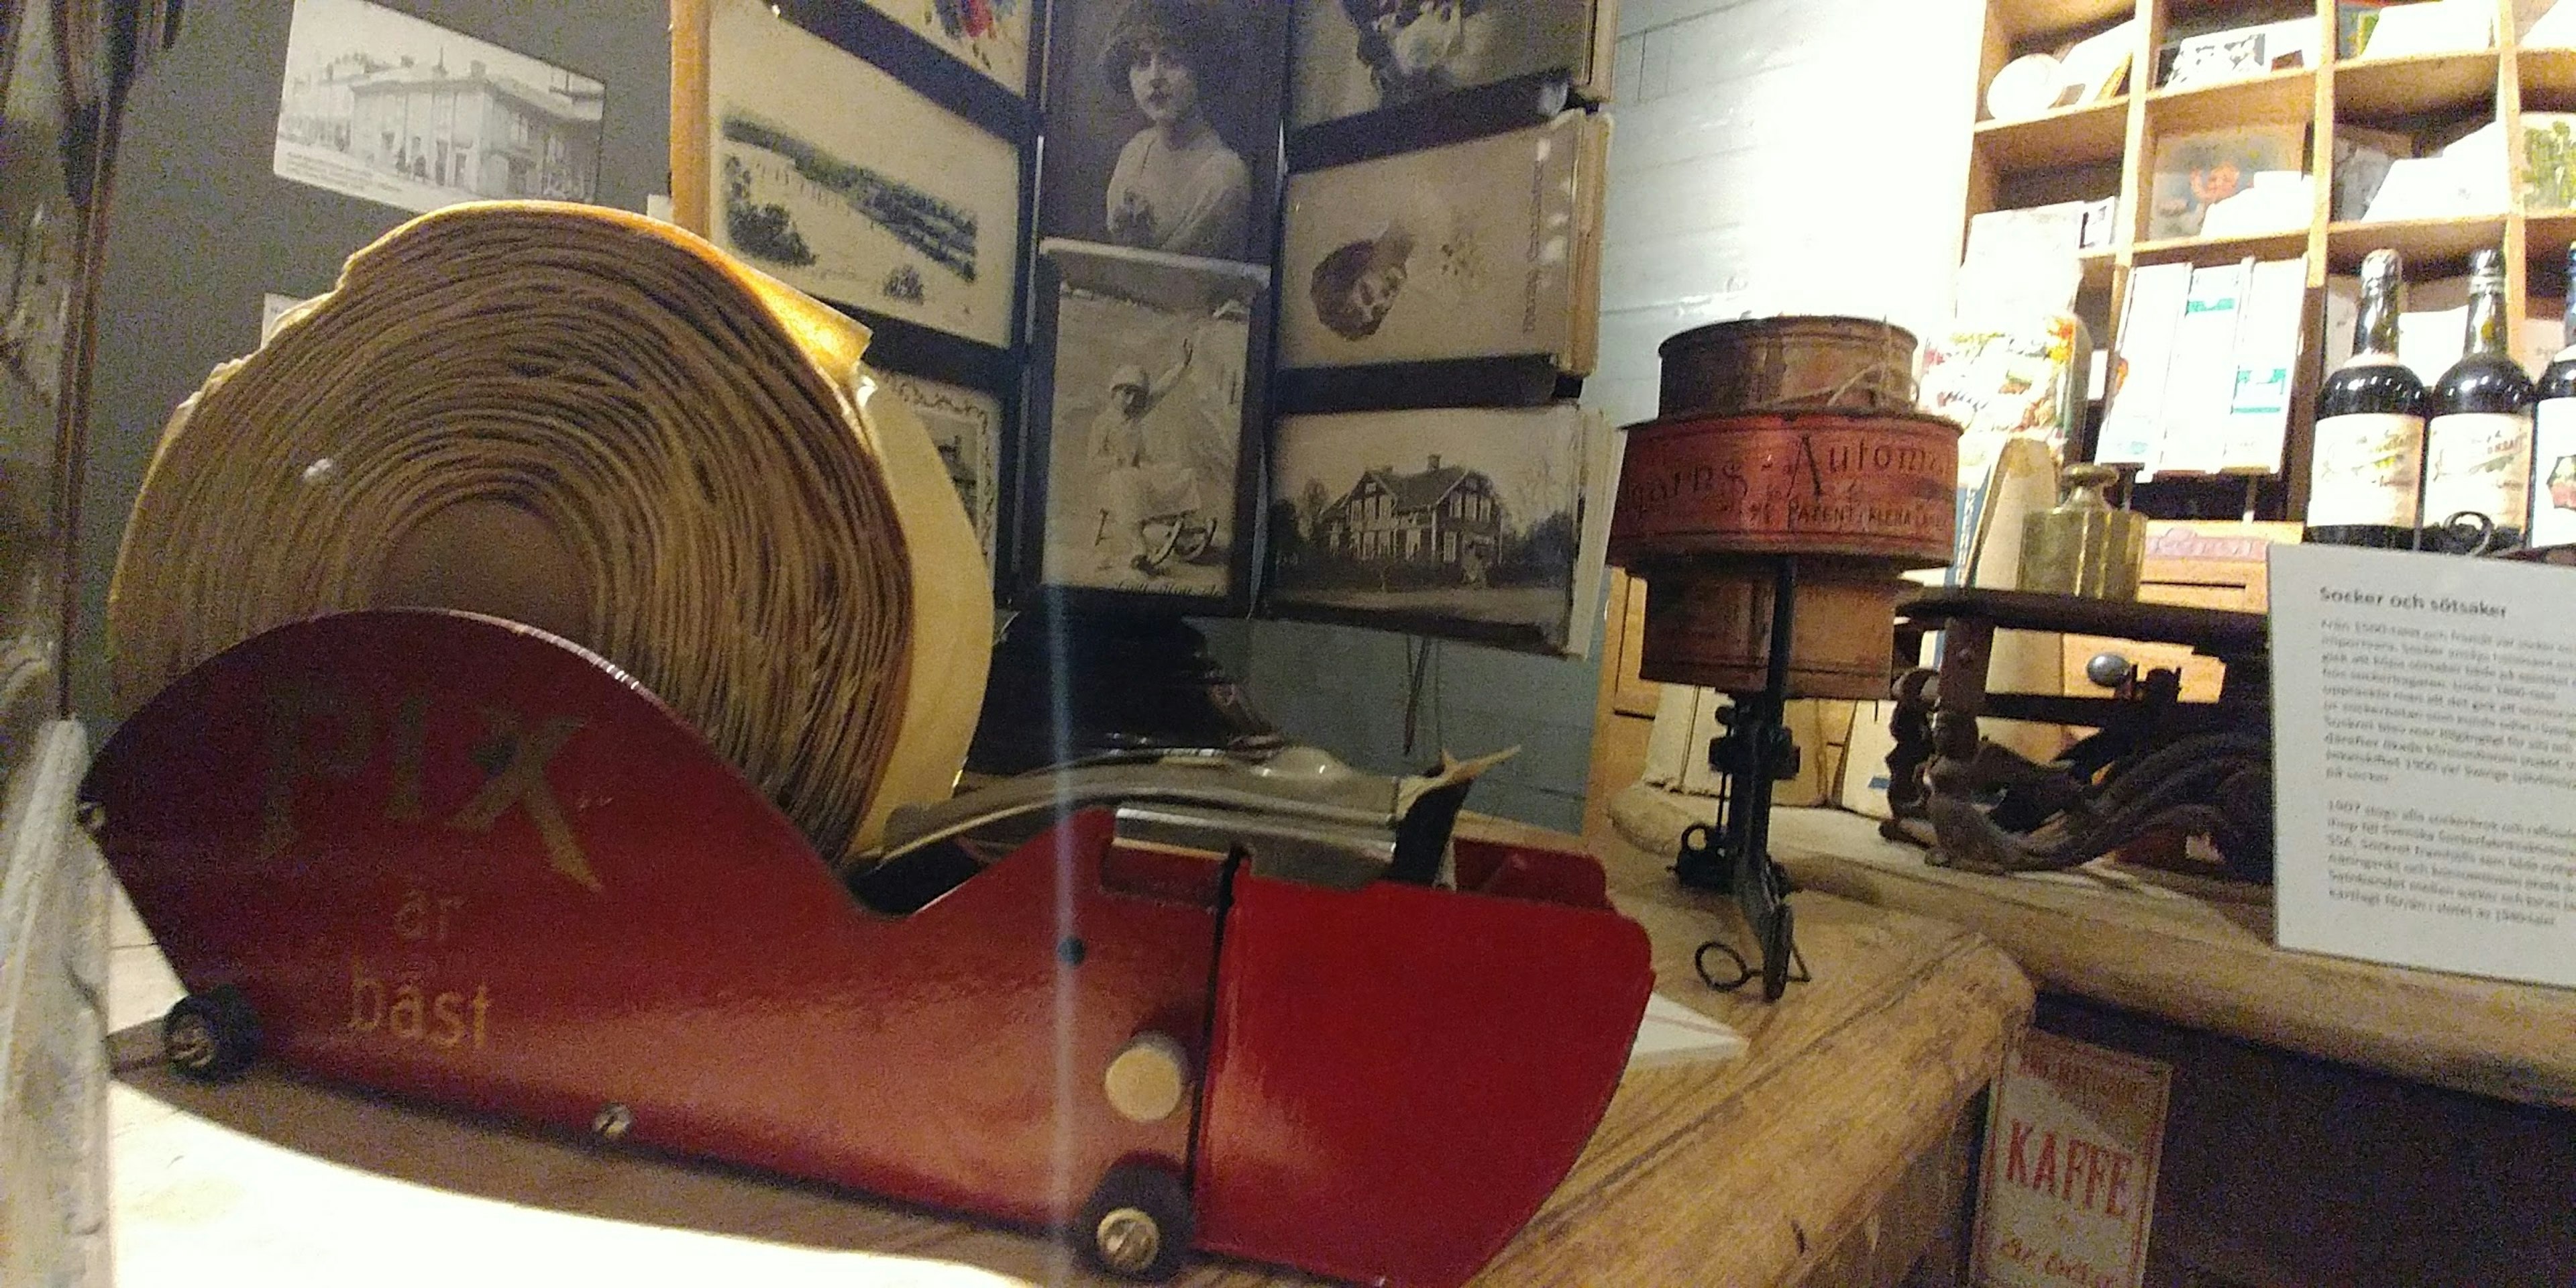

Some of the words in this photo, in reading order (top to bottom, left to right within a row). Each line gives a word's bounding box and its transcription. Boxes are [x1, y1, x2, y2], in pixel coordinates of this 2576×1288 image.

[2320, 586, 2384, 605] Socker
[2390, 594, 2425, 609] och
[2430, 599, 2507, 618] sötsaker
[259, 683, 604, 892] PIX
[396, 887, 465, 941] är
[347, 955, 492, 1049] bäst
[2005, 1119, 2134, 1218] KAFFE
